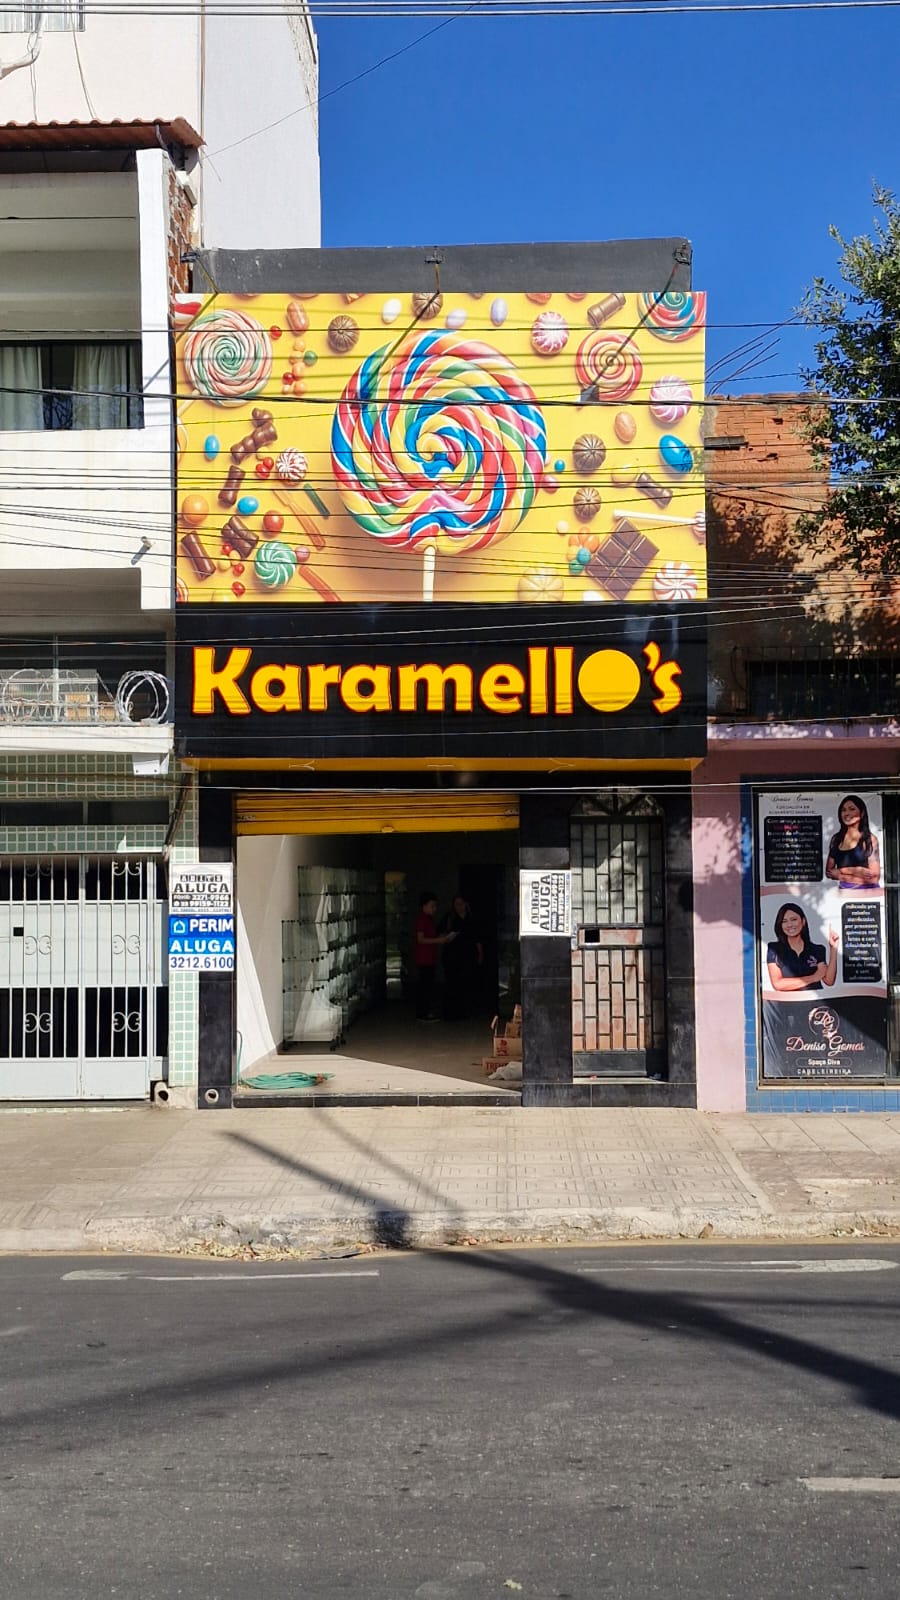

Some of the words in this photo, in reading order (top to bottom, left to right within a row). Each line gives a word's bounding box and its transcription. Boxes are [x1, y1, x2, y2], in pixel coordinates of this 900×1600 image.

[174, 883, 229, 893] ALUGA
[540, 874, 551, 931] ALUGA
[189, 918, 234, 933] PERIM
[170, 940, 234, 952] ALUGA
[170, 956, 234, 969] 3212.6100
[786, 1036, 827, 1052] Denise
[827, 1035, 865, 1057] Gomes
